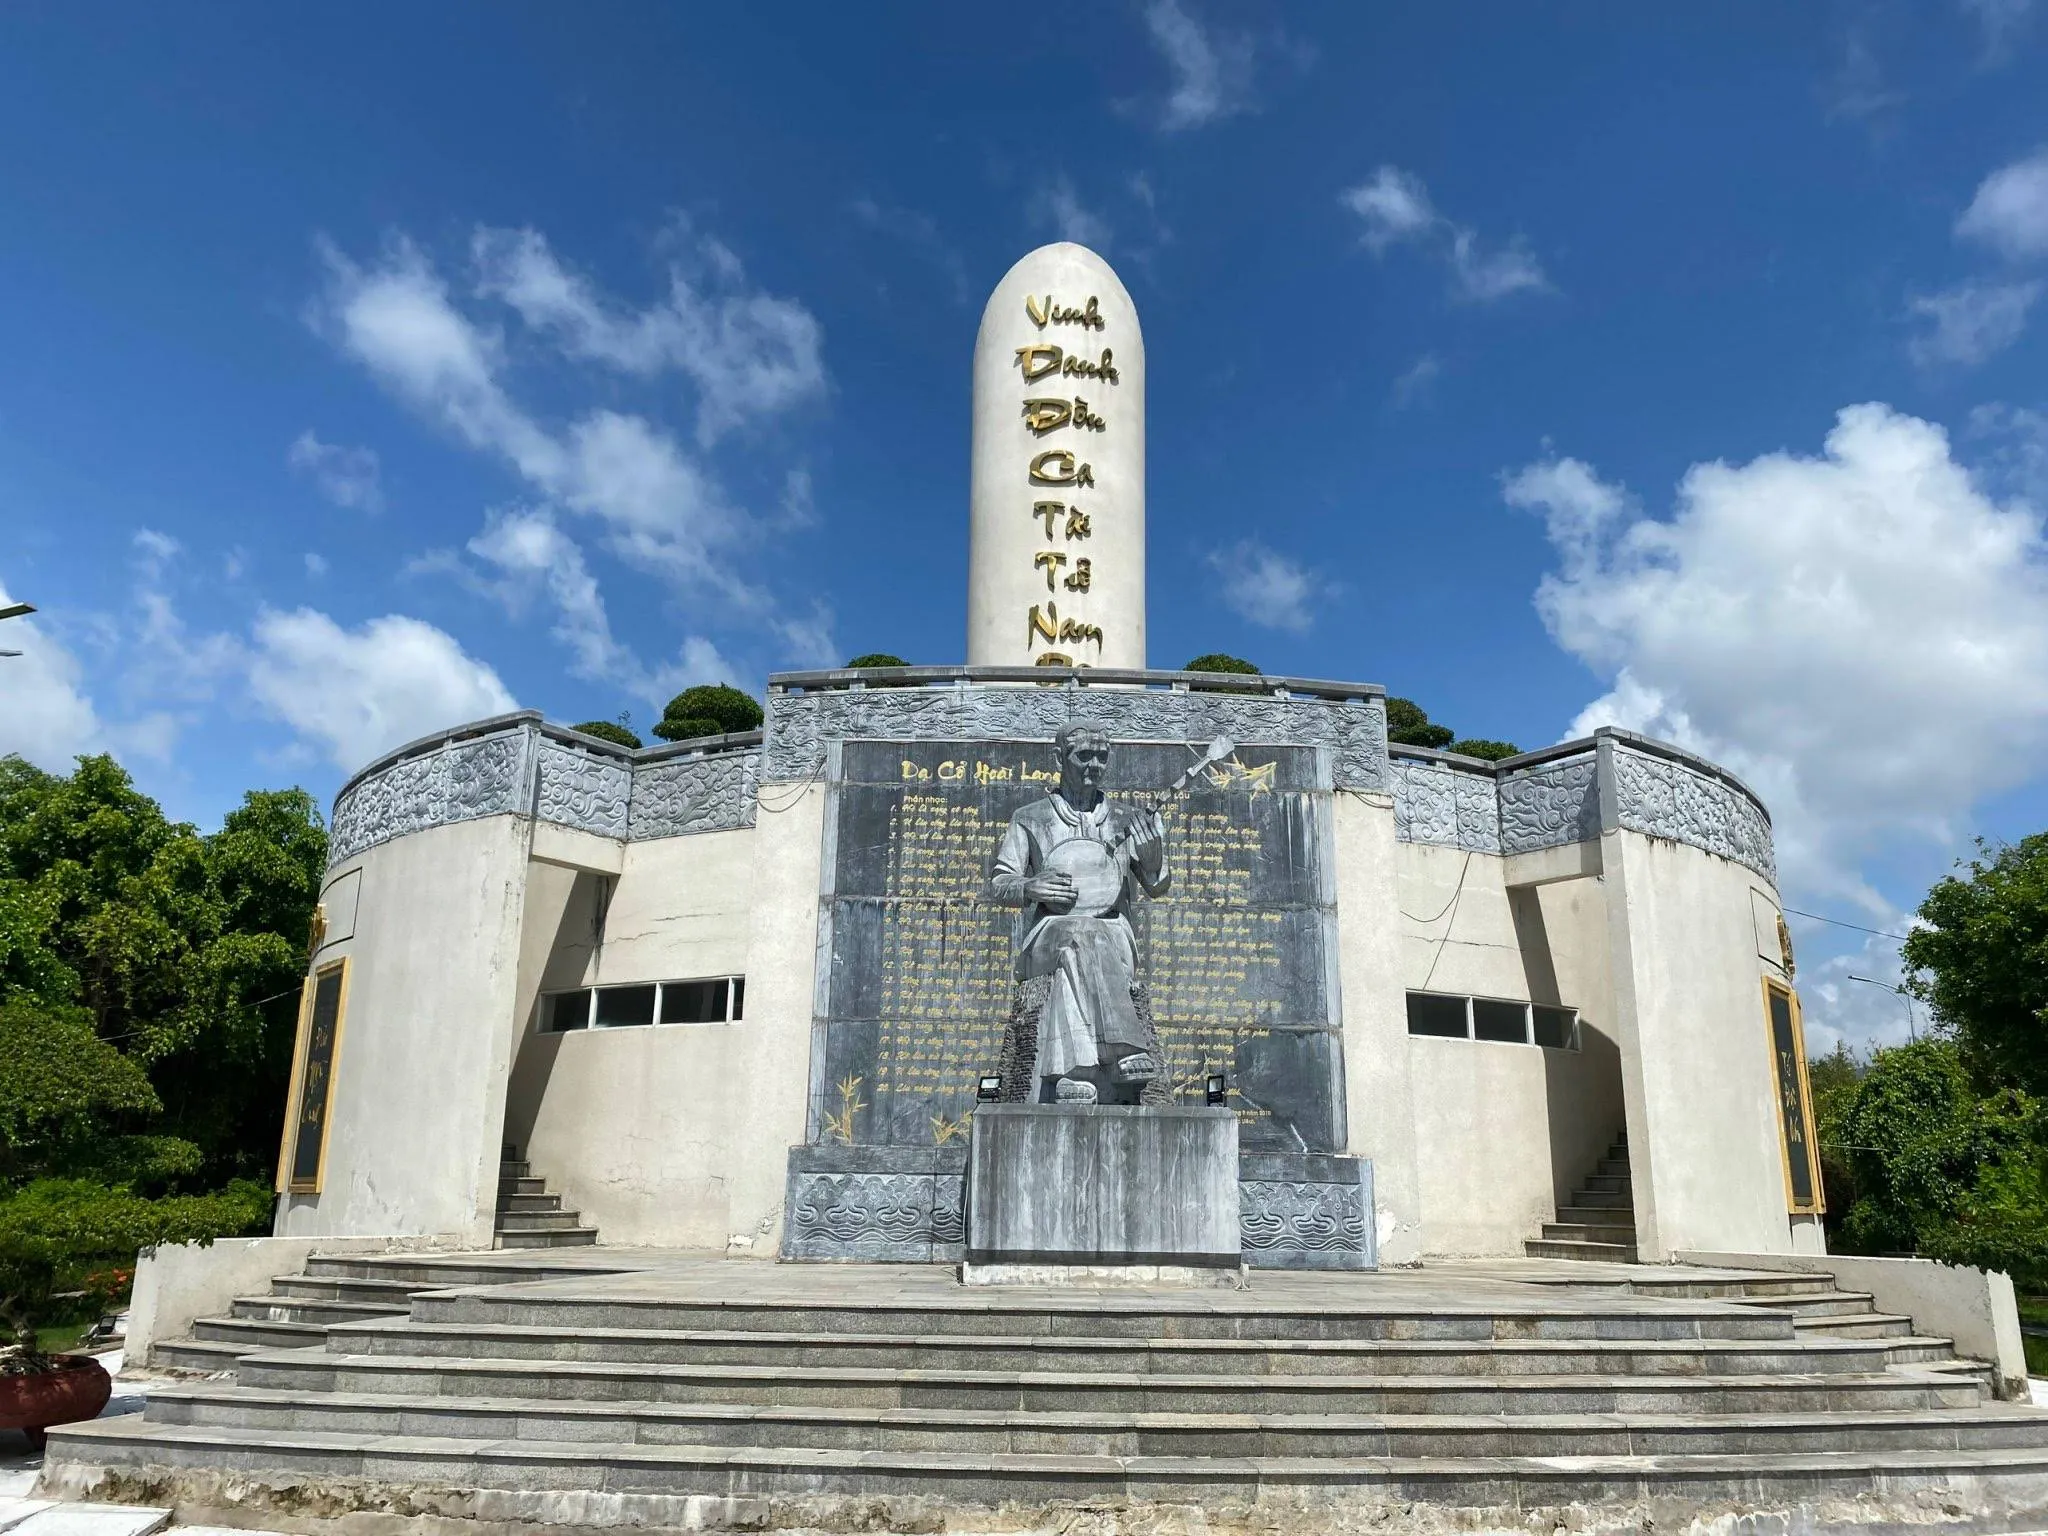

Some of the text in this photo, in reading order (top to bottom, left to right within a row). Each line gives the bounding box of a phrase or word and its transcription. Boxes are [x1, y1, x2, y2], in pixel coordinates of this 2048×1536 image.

[1026, 294, 1105, 329] Vinh
[1014, 344, 1119, 383] Danh
[1029, 449, 1094, 486] Ca
[1033, 500, 1092, 542] Tài
[1027, 601, 1104, 655] Nam
[901, 760, 932, 781] Dạ
[937, 759, 968, 780] Cổ
[1132, 790, 1152, 799] Cao
